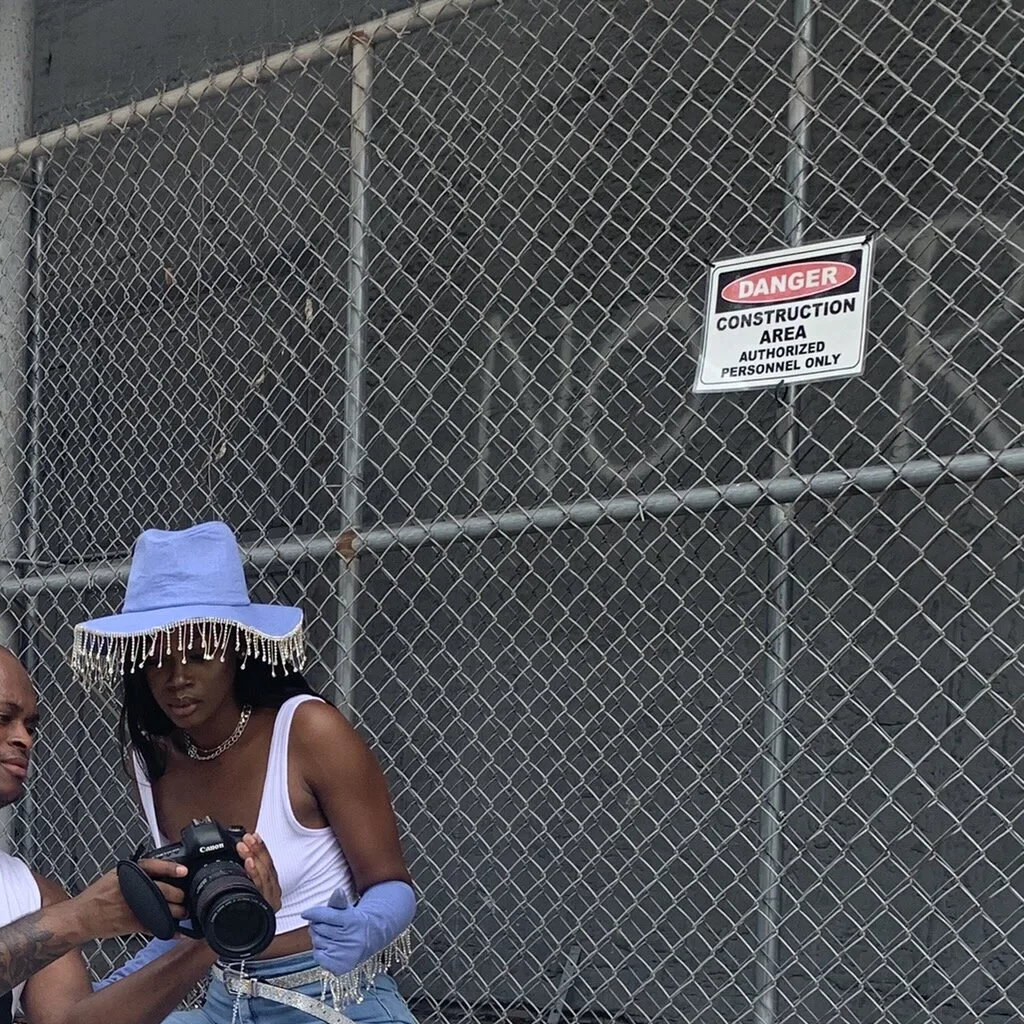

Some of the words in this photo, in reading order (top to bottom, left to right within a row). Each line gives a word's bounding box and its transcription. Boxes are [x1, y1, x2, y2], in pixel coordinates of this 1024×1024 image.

[738, 267, 838, 299] DANGER
[716, 297, 856, 331] CONSTRUCTION
[759, 325, 807, 344] AREA
[739, 341, 825, 362] AUTHORIZED
[721, 360, 801, 378] PERSONNEL
[805, 353, 841, 369] ONLY
[199, 842, 225, 853] Canon
